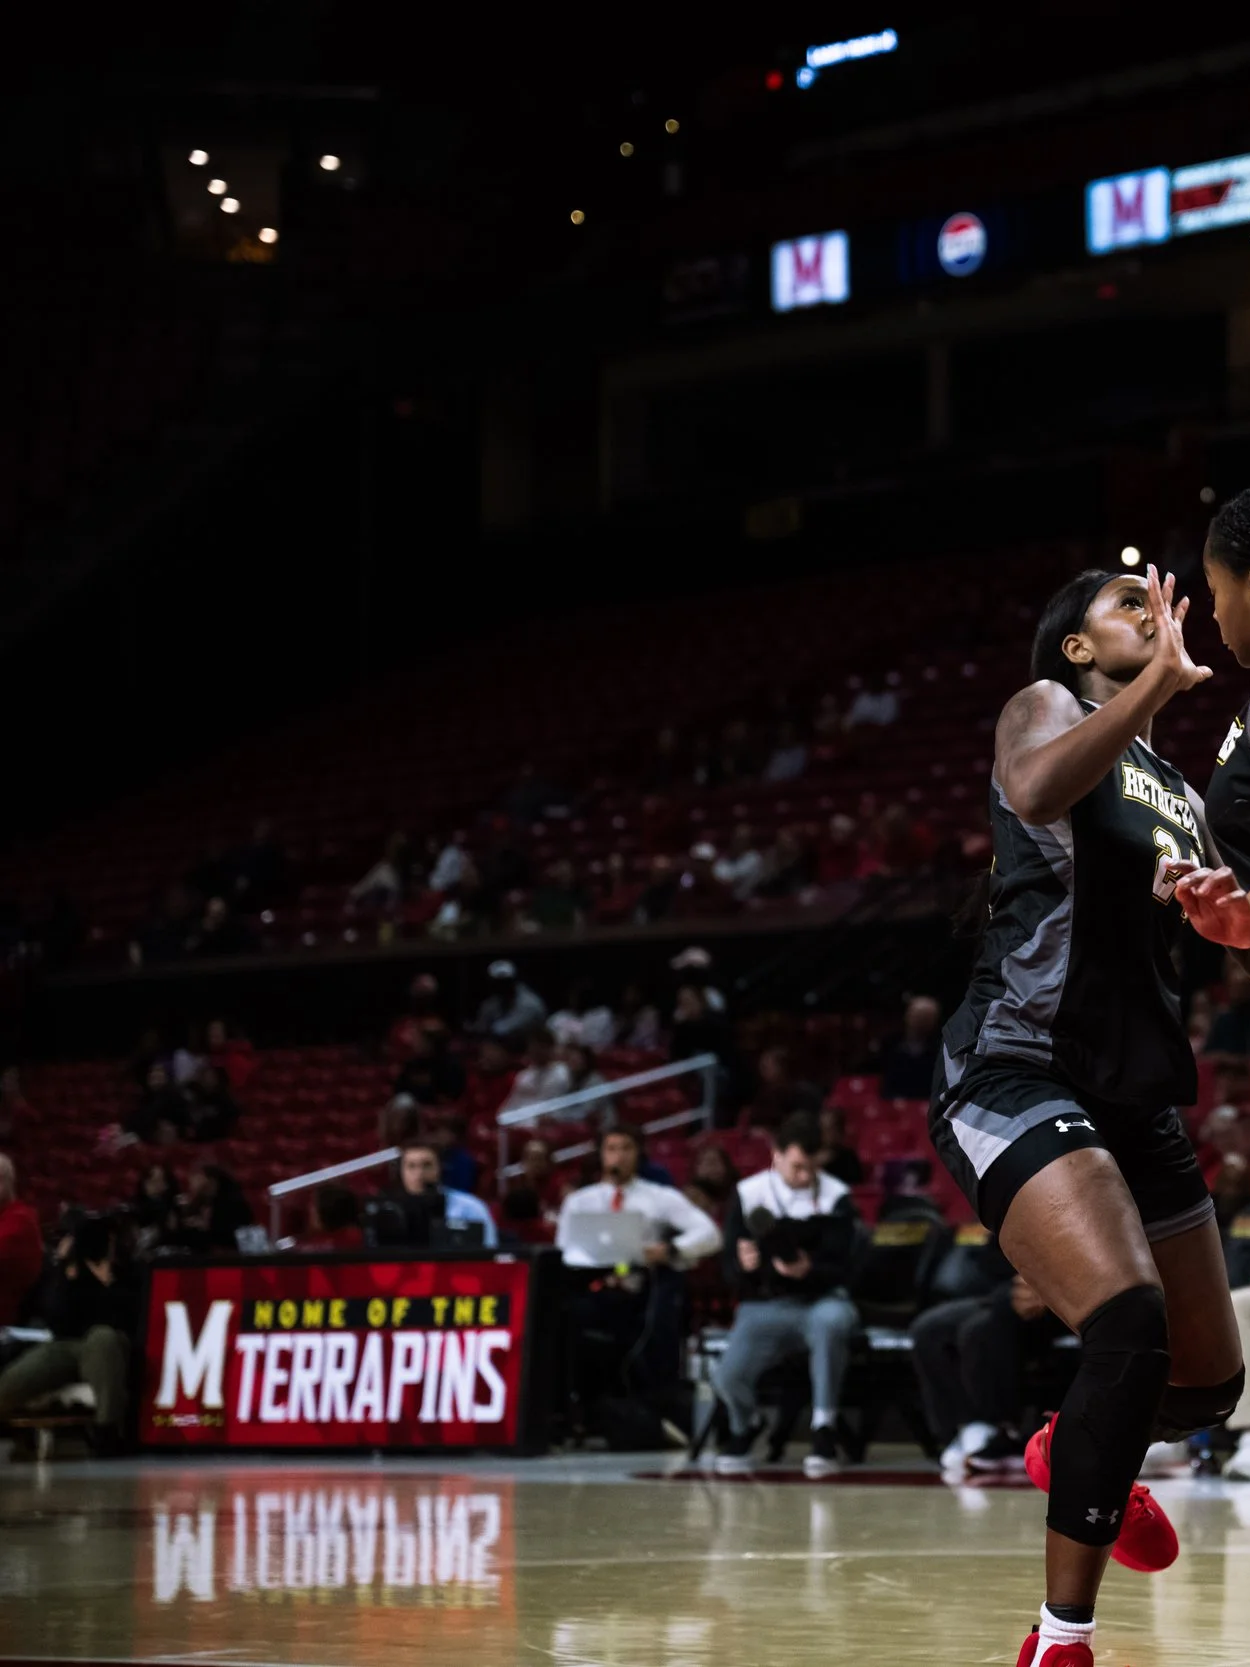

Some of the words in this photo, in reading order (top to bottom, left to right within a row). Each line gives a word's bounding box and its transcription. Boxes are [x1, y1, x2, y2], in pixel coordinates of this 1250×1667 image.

[1152, 825, 1202, 906] 2
[154, 1300, 235, 1409] M
[254, 1299, 347, 1329] HOME
[367, 1297, 410, 1328] OF
[433, 1296, 500, 1326] THE
[236, 1330, 512, 1424] TERRAPINS
